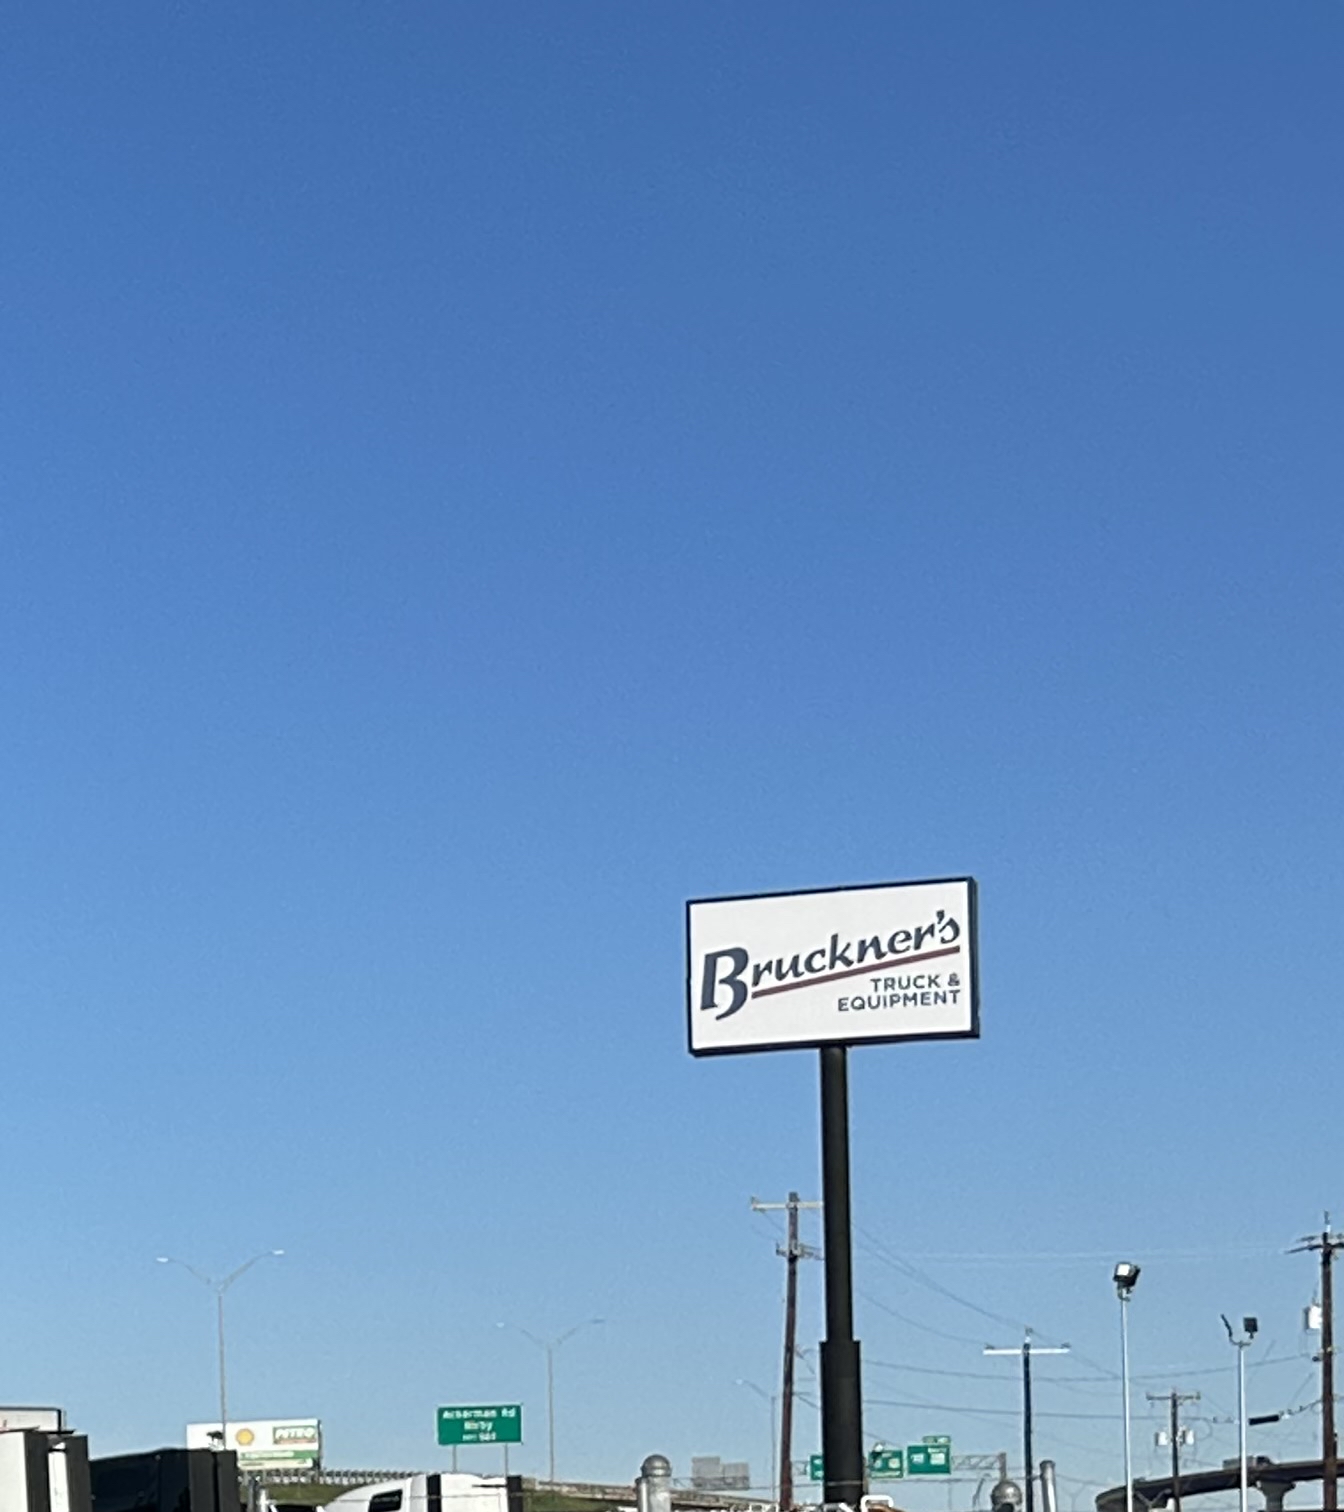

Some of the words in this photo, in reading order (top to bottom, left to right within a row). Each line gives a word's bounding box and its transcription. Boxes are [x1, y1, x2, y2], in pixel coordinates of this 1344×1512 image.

[700, 909, 961, 1021] Bruckner's
[870, 975, 941, 993] TRUCK
[948, 972, 961, 988] &
[838, 989, 961, 1012] EQUIPMENT
